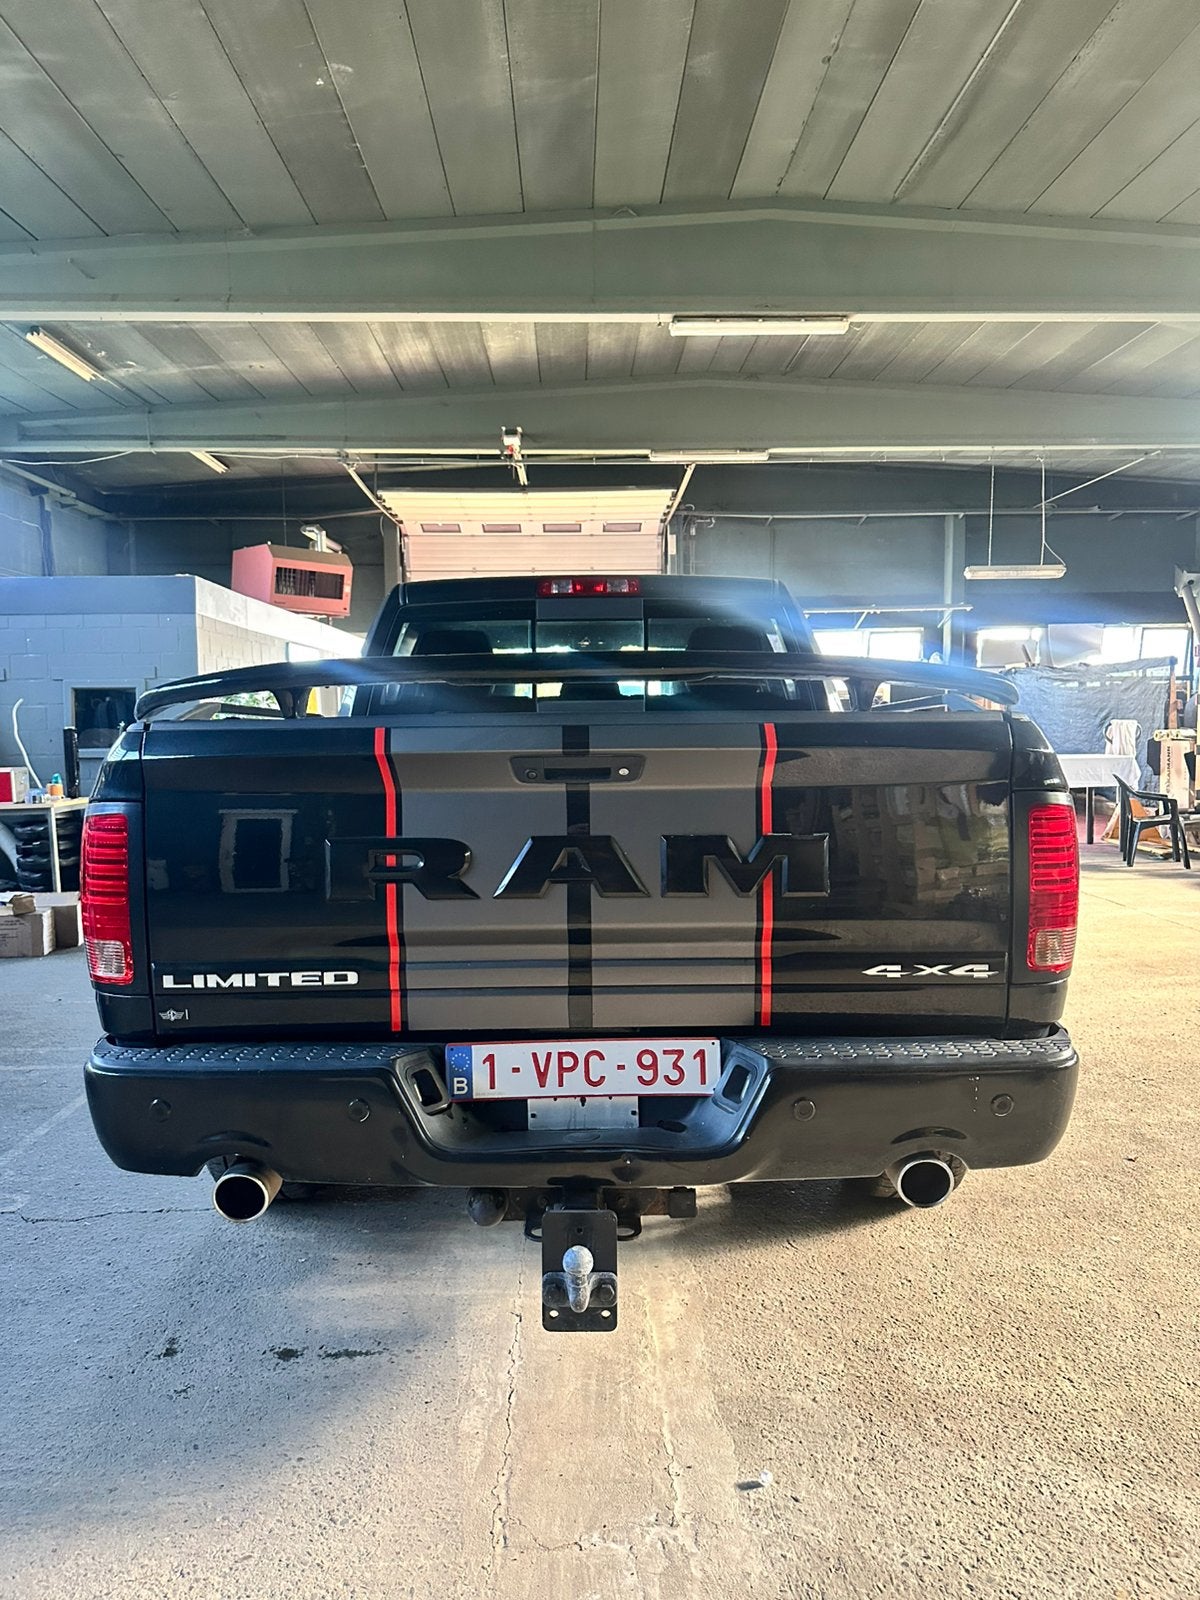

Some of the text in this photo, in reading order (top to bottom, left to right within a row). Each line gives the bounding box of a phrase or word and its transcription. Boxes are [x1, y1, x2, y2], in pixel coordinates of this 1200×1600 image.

[324, 832, 831, 901] RAM
[162, 970, 360, 989] LIMITED
[482, 1048, 707, 1090] 1-VPC-931
[453, 1076, 469, 1095] B
